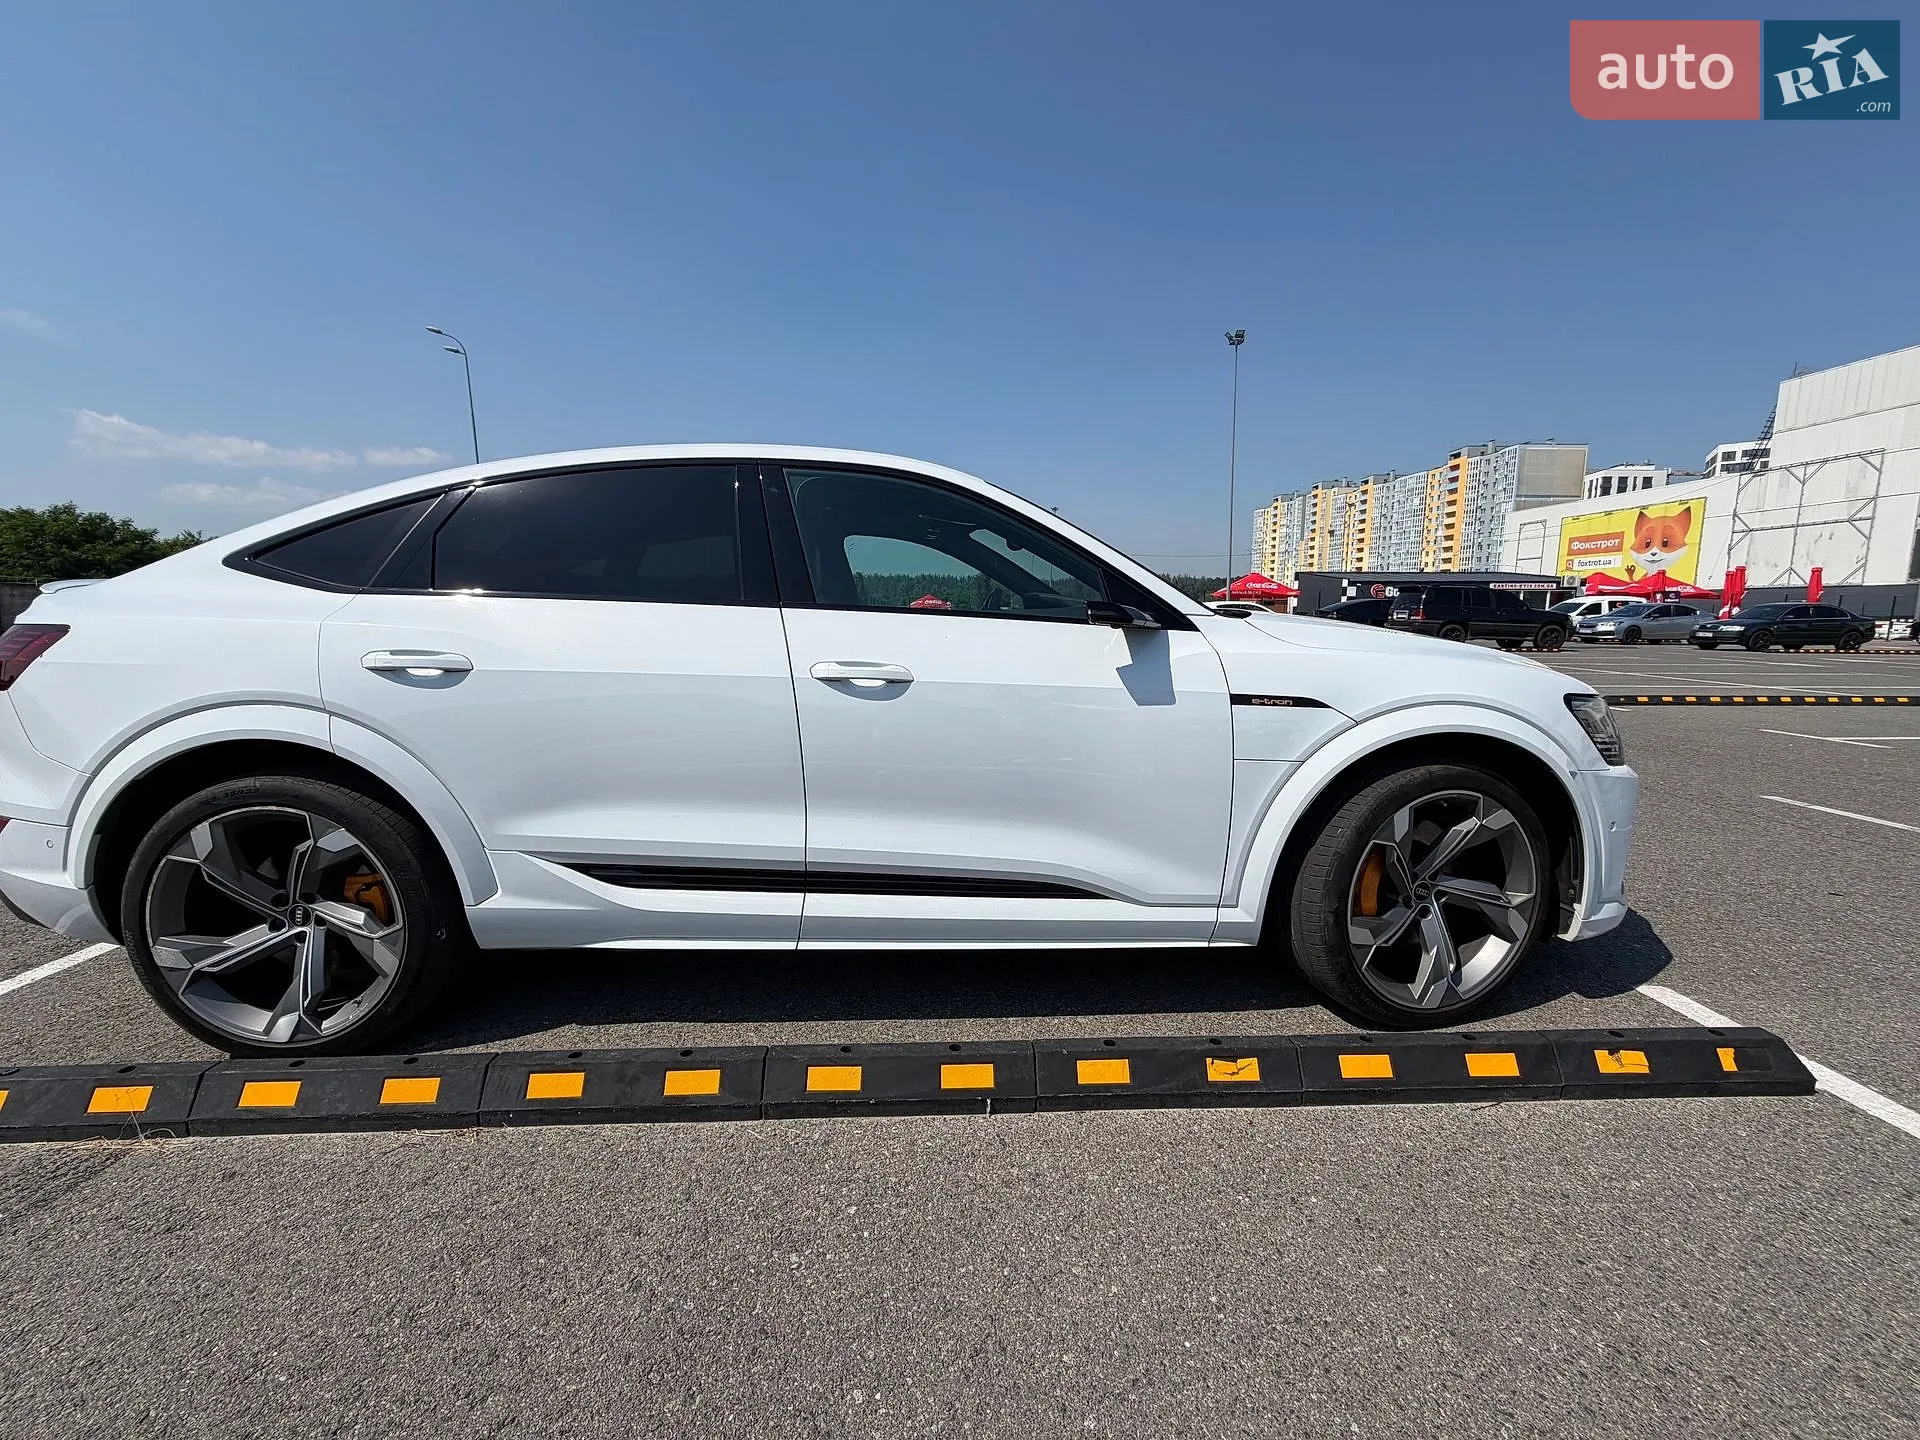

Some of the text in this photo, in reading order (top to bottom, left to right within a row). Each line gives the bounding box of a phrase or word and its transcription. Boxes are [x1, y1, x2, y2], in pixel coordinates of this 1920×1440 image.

[1571, 538, 1621, 550] Фокстрот
[1577, 558, 1612, 568] foxtrot.ua
[1251, 698, 1293, 706] e-tron
